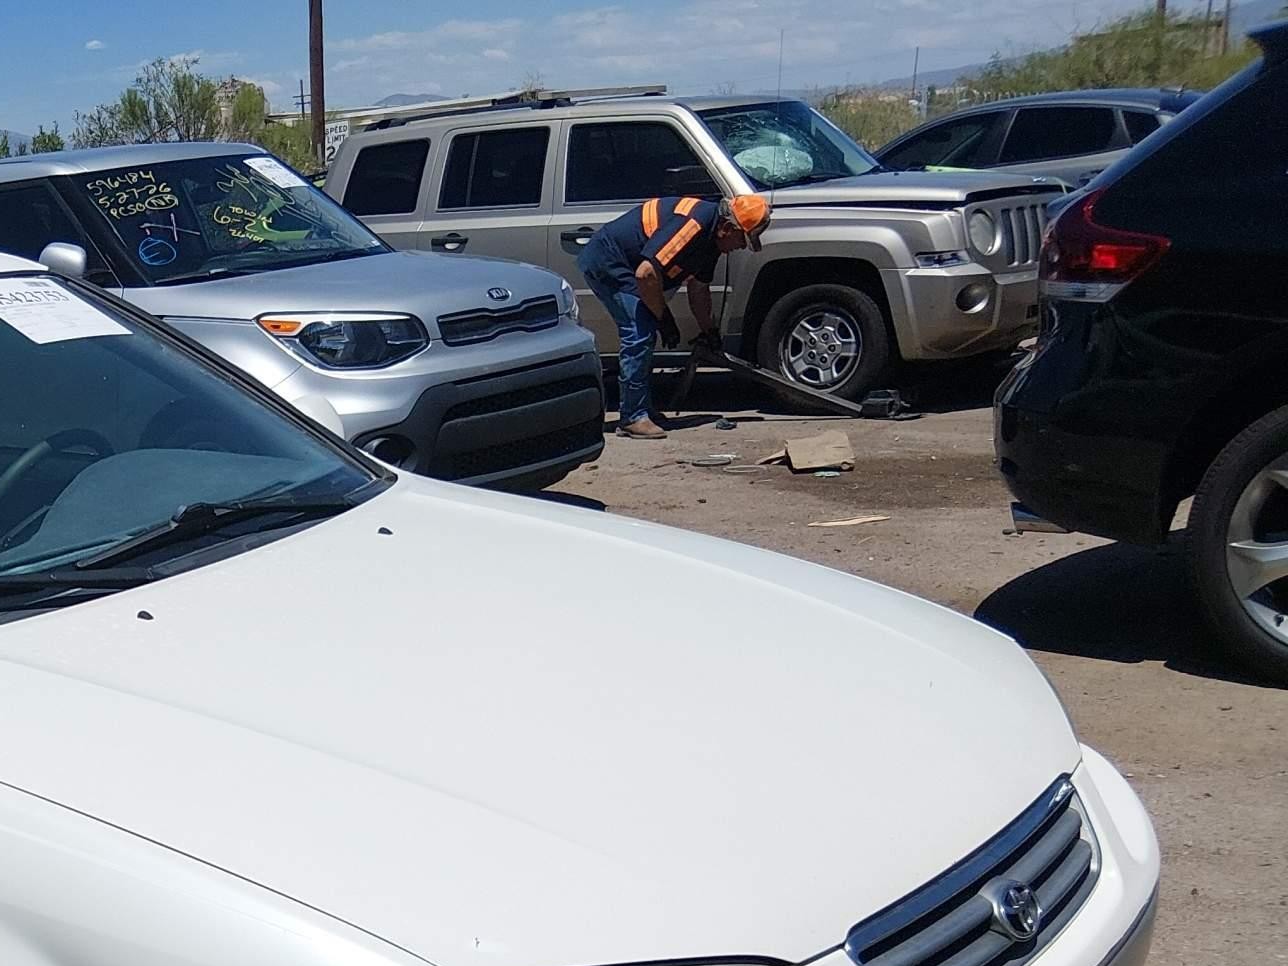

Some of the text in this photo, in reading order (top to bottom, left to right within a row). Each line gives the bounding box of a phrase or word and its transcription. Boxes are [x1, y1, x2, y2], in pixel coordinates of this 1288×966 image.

[325, 125, 348, 136] SPEED
[327, 134, 346, 144] LIMIT
[489, 288, 509, 299] KIA
